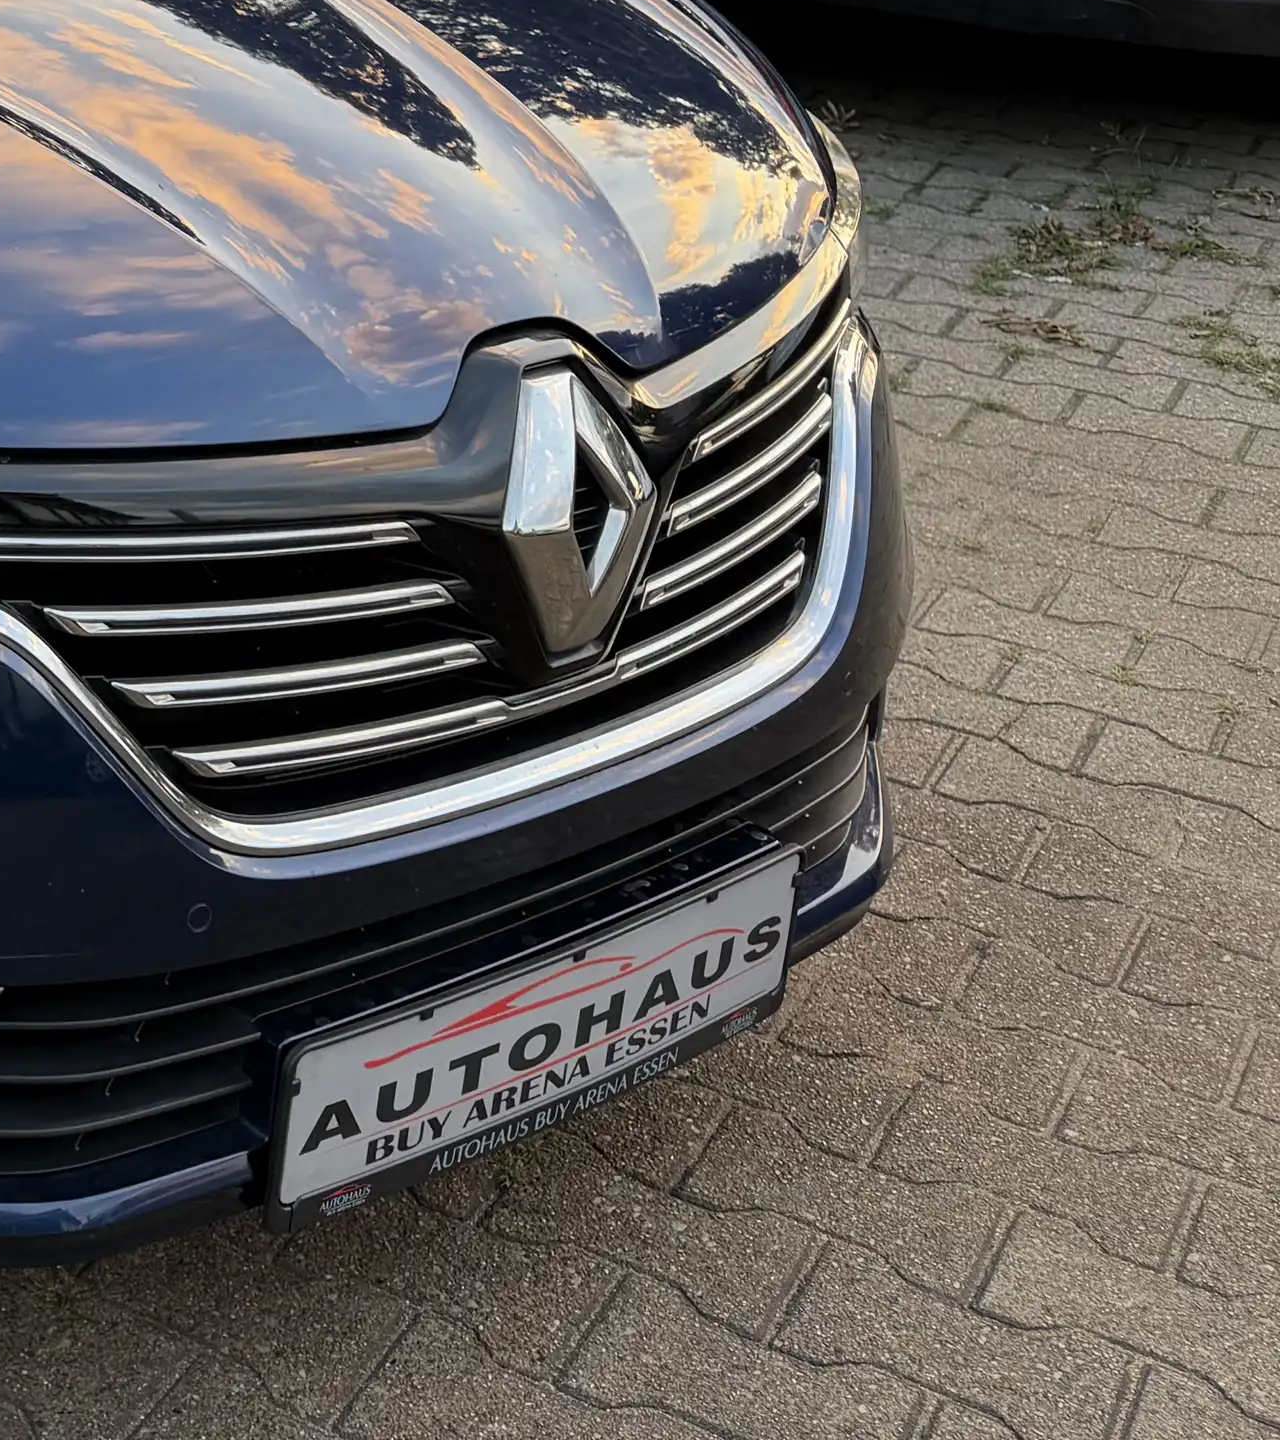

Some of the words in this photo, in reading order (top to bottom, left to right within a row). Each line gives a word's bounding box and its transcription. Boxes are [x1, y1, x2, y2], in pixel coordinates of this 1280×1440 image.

[298, 915, 782, 1157] AUTOHAUS
[365, 1111, 452, 1166] BUY
[462, 1055, 591, 1129] ARENA
[604, 994, 712, 1068] ESSEN
[428, 1117, 529, 1175] AUTOHAUS
[534, 1100, 571, 1131] BUY
[572, 1074, 628, 1115] ARENA
[632, 1046, 680, 1086] ESSEN
